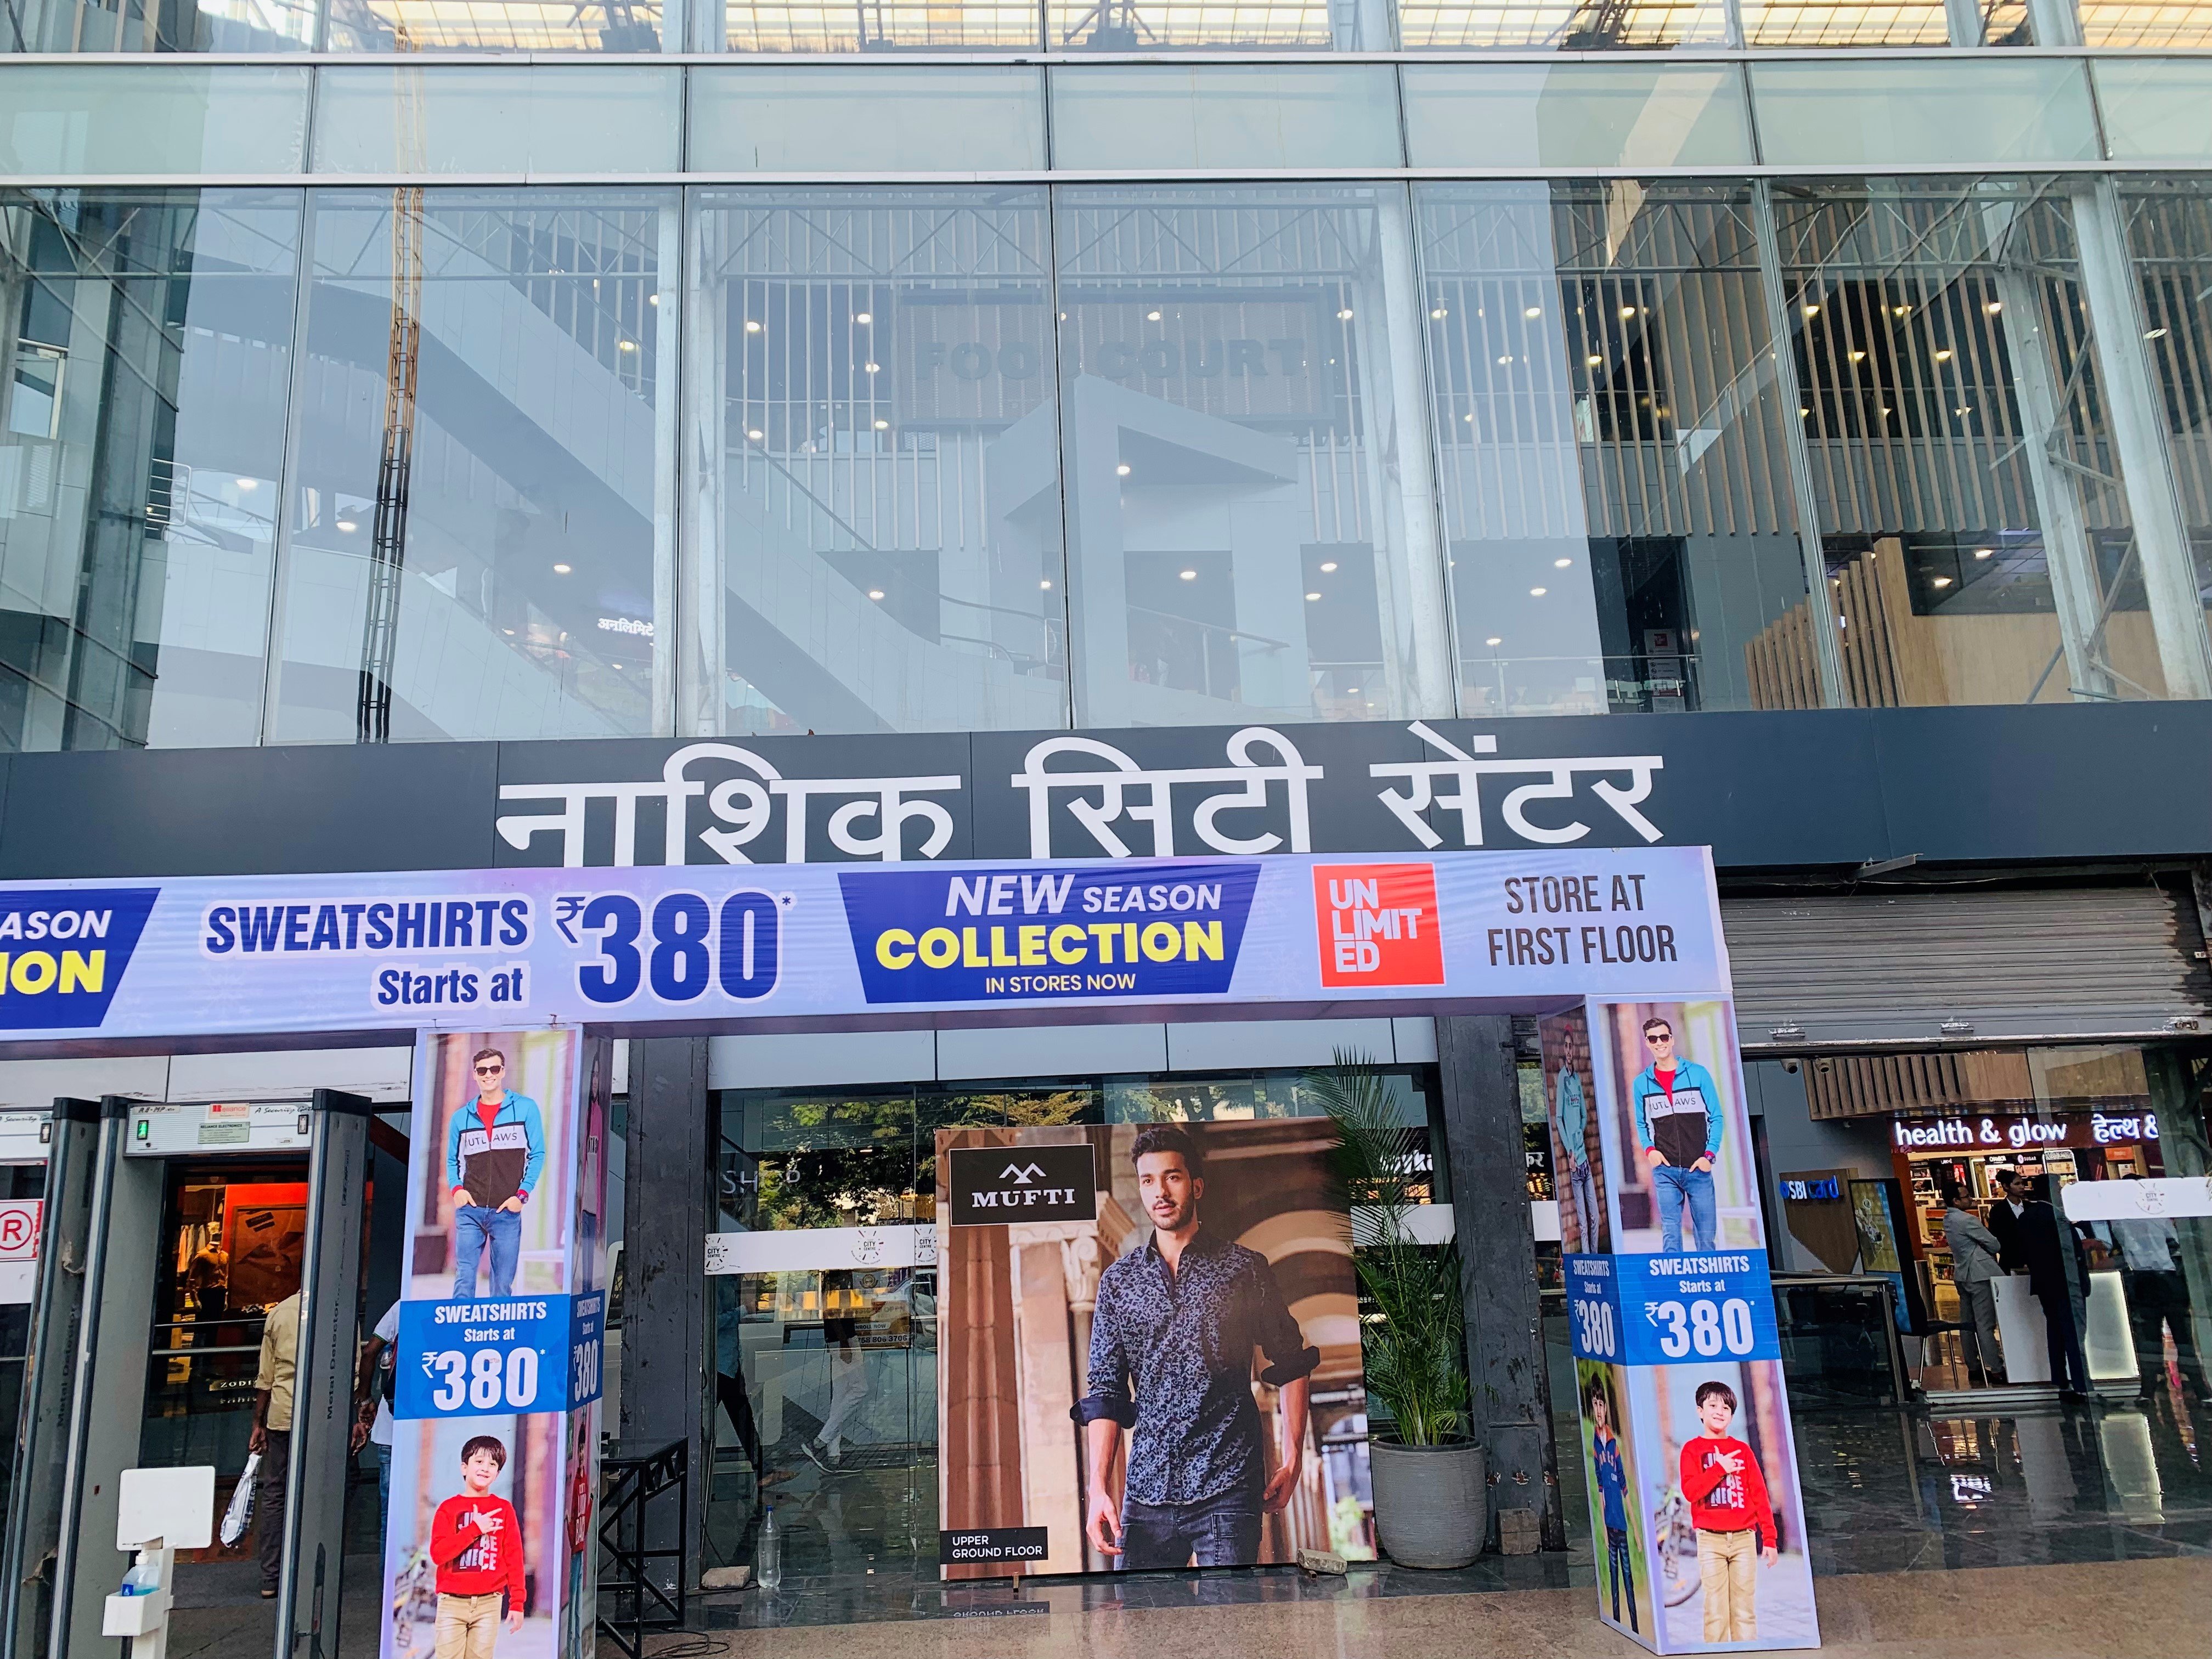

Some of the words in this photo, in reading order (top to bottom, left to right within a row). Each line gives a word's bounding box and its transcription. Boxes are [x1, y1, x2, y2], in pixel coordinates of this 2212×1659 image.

[1097, 338, 1305, 379] COURT
[597, 618, 653, 636] अनलिमिटे
[496, 743, 961, 867] नाशिक
[1011, 727, 1323, 859] सिटी
[1370, 720, 1664, 849] सेंटर
[944, 873, 1076, 917] NEW
[1082, 884, 1222, 913] SEASON
[1505, 874, 1602, 915] STORE
[1611, 873, 1646, 912] AT
[206, 899, 528, 953] SWEATSHIRTS
[876, 921, 1225, 970] COLLECTION
[1487, 927, 1571, 967] FIRST
[1581, 925, 1678, 964] FLOOR
[377, 969, 478, 1005] Starts
[490, 968, 523, 1002] at
[986, 977, 1005, 994] IN
[1010, 975, 1082, 993] STORES
[1087, 973, 1136, 991] NOW
[1895, 1120, 1974, 1146] health
[1979, 1118, 2002, 1144] &
[2008, 1118, 2067, 1148] glow
[2091, 1113, 2140, 1143] हेल्थ
[721, 1170, 800, 1194] SHP
[1788, 1180, 1807, 1199] SBI
[1807, 1175, 1839, 1199] card
[972, 1188, 1075, 1207] MUFTI
[1573, 1260, 1610, 1277] SWEATSHIRTS
[1649, 1255, 1750, 1276] SWEATSHIRTS
[1584, 1281, 1596, 1294] Starts
[1679, 1280, 1712, 1293] Starts
[1714, 1279, 1726, 1292] at
[435, 1302, 546, 1324] SWEATSHIRTS
[464, 1328, 500, 1342] Starts
[503, 1327, 515, 1340] at
[1726, 1474, 1743, 1491] BE
[479, 1534, 498, 1552] BE
[952, 1535, 989, 1546] UPPER
[952, 1547, 1002, 1559] GROUND
[1005, 1545, 1042, 1556] FLOOR
